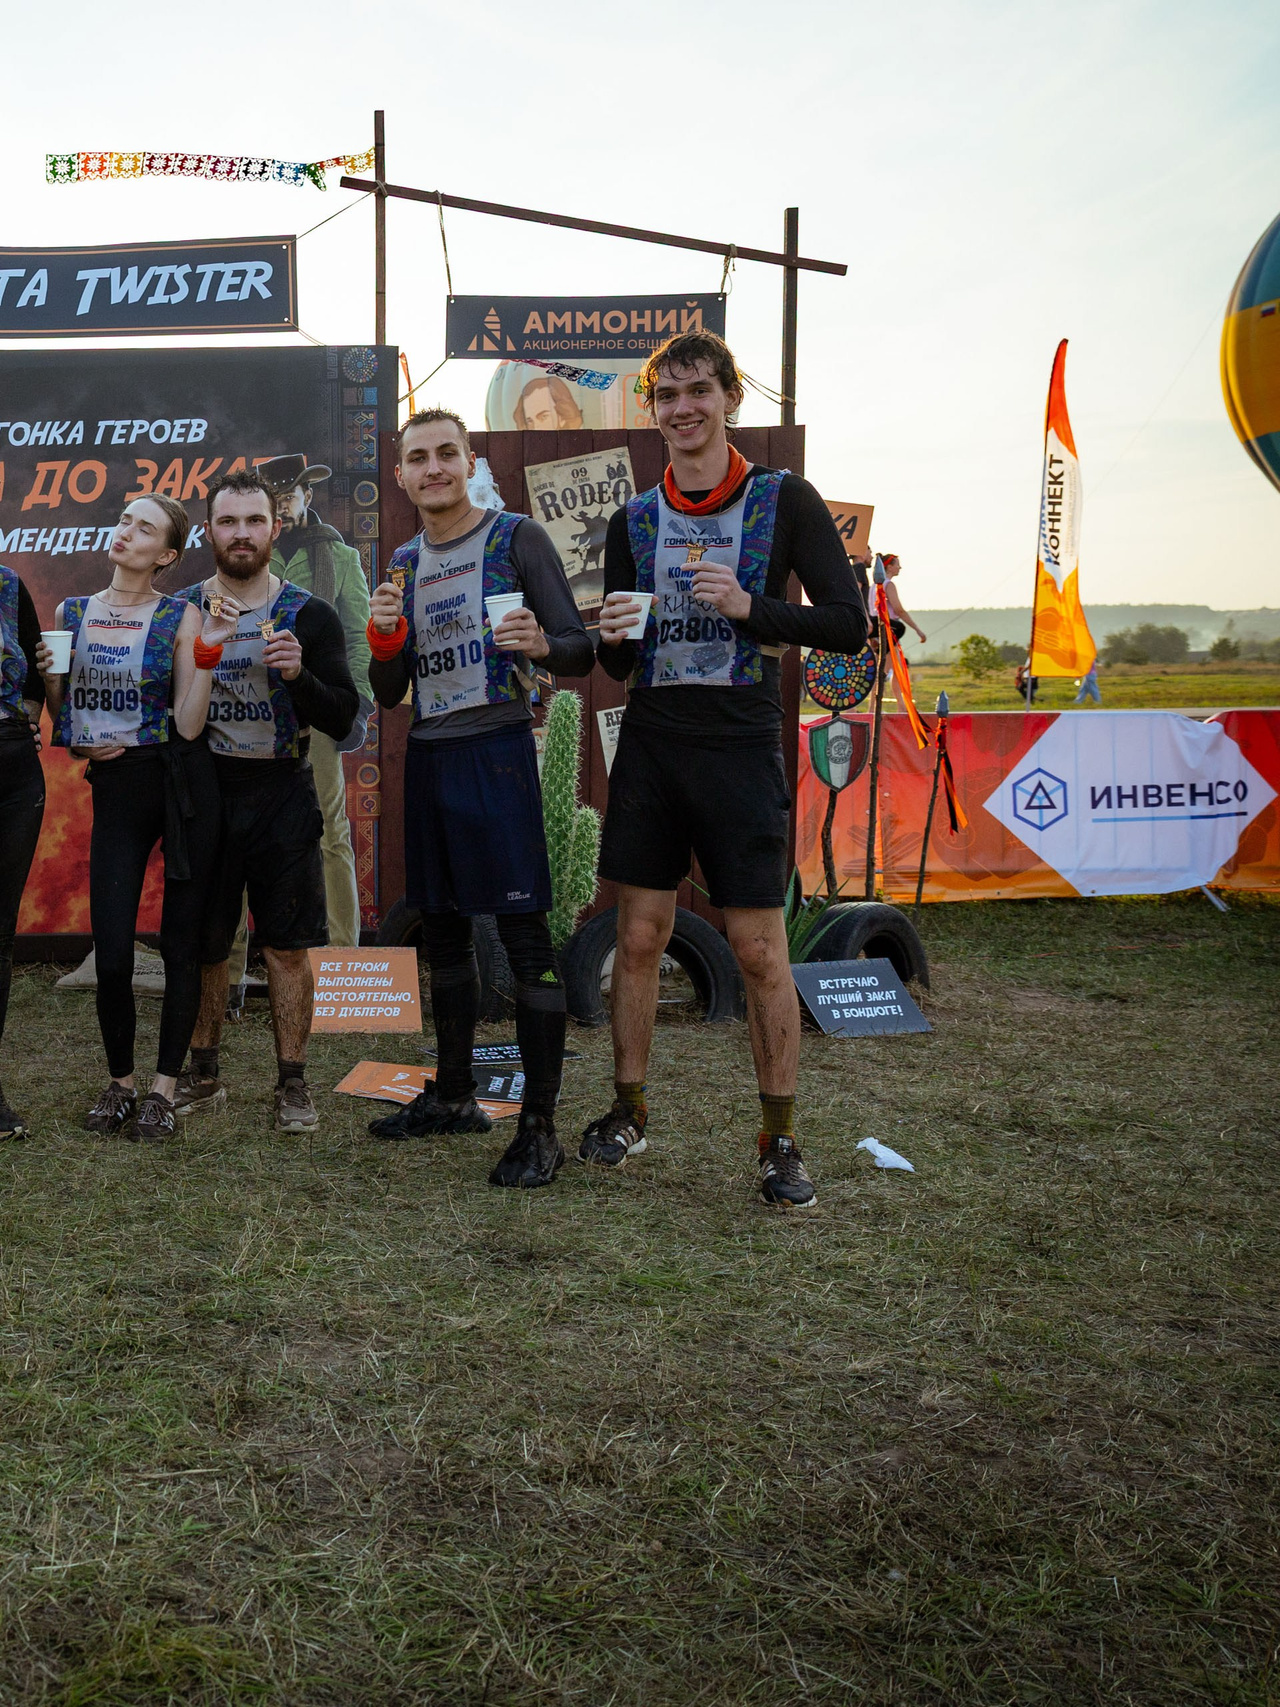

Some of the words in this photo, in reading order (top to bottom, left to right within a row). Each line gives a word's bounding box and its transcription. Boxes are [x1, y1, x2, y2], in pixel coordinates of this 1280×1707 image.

[76, 261, 273, 316] TWISTER
[523, 301, 703, 334] АММОНИЙ
[523, 339, 624, 351] АКЦИОНЕРНОЕ
[94, 418, 208, 445] ГЕРОЕВ
[571, 467, 588, 479] 09
[21, 460, 108, 511] ДО
[535, 478, 633, 523] RODEO
[1047, 454, 1065, 566] КОННЕКТ
[696, 536, 733, 545] ГЕРОЕВ
[420, 572, 442, 585] ГОНКА
[444, 561, 476, 577] ГЕРОЕВ
[425, 593, 466, 615] КОМАНДА
[88, 619, 111, 627] ГОНКА
[112, 619, 143, 628] ГЕРОЕВ
[659, 616, 733, 644] 03806
[87, 643, 130, 656] КОМАНДА
[419, 640, 483, 679] 03810
[212, 657, 253, 671] ОМАНДА
[77, 666, 138, 688] АРИНА
[74, 688, 139, 712] 03809
[207, 701, 273, 722] 03808
[1090, 779, 1249, 810] ИНВЕНСО
[320, 962, 342, 972] ВСЕ
[347, 961, 389, 972] ТРЮКИ
[318, 976, 393, 987] ВЫПОЛНЕНЫ
[818, 976, 879, 990] ВСТРЕЧАЮ
[313, 991, 415, 1004] МОСТОЯТЕЛЬНО.
[817, 991, 863, 1005] ЛУЧШИЙ
[865, 990, 897, 1002] ЗАКАТ
[315, 1007, 336, 1017] БЕЗ
[338, 1006, 401, 1018] ДУБЛЕРОВ
[831, 1009, 840, 1019] В
[842, 1005, 904, 1019] БОНДЮГЕ!
